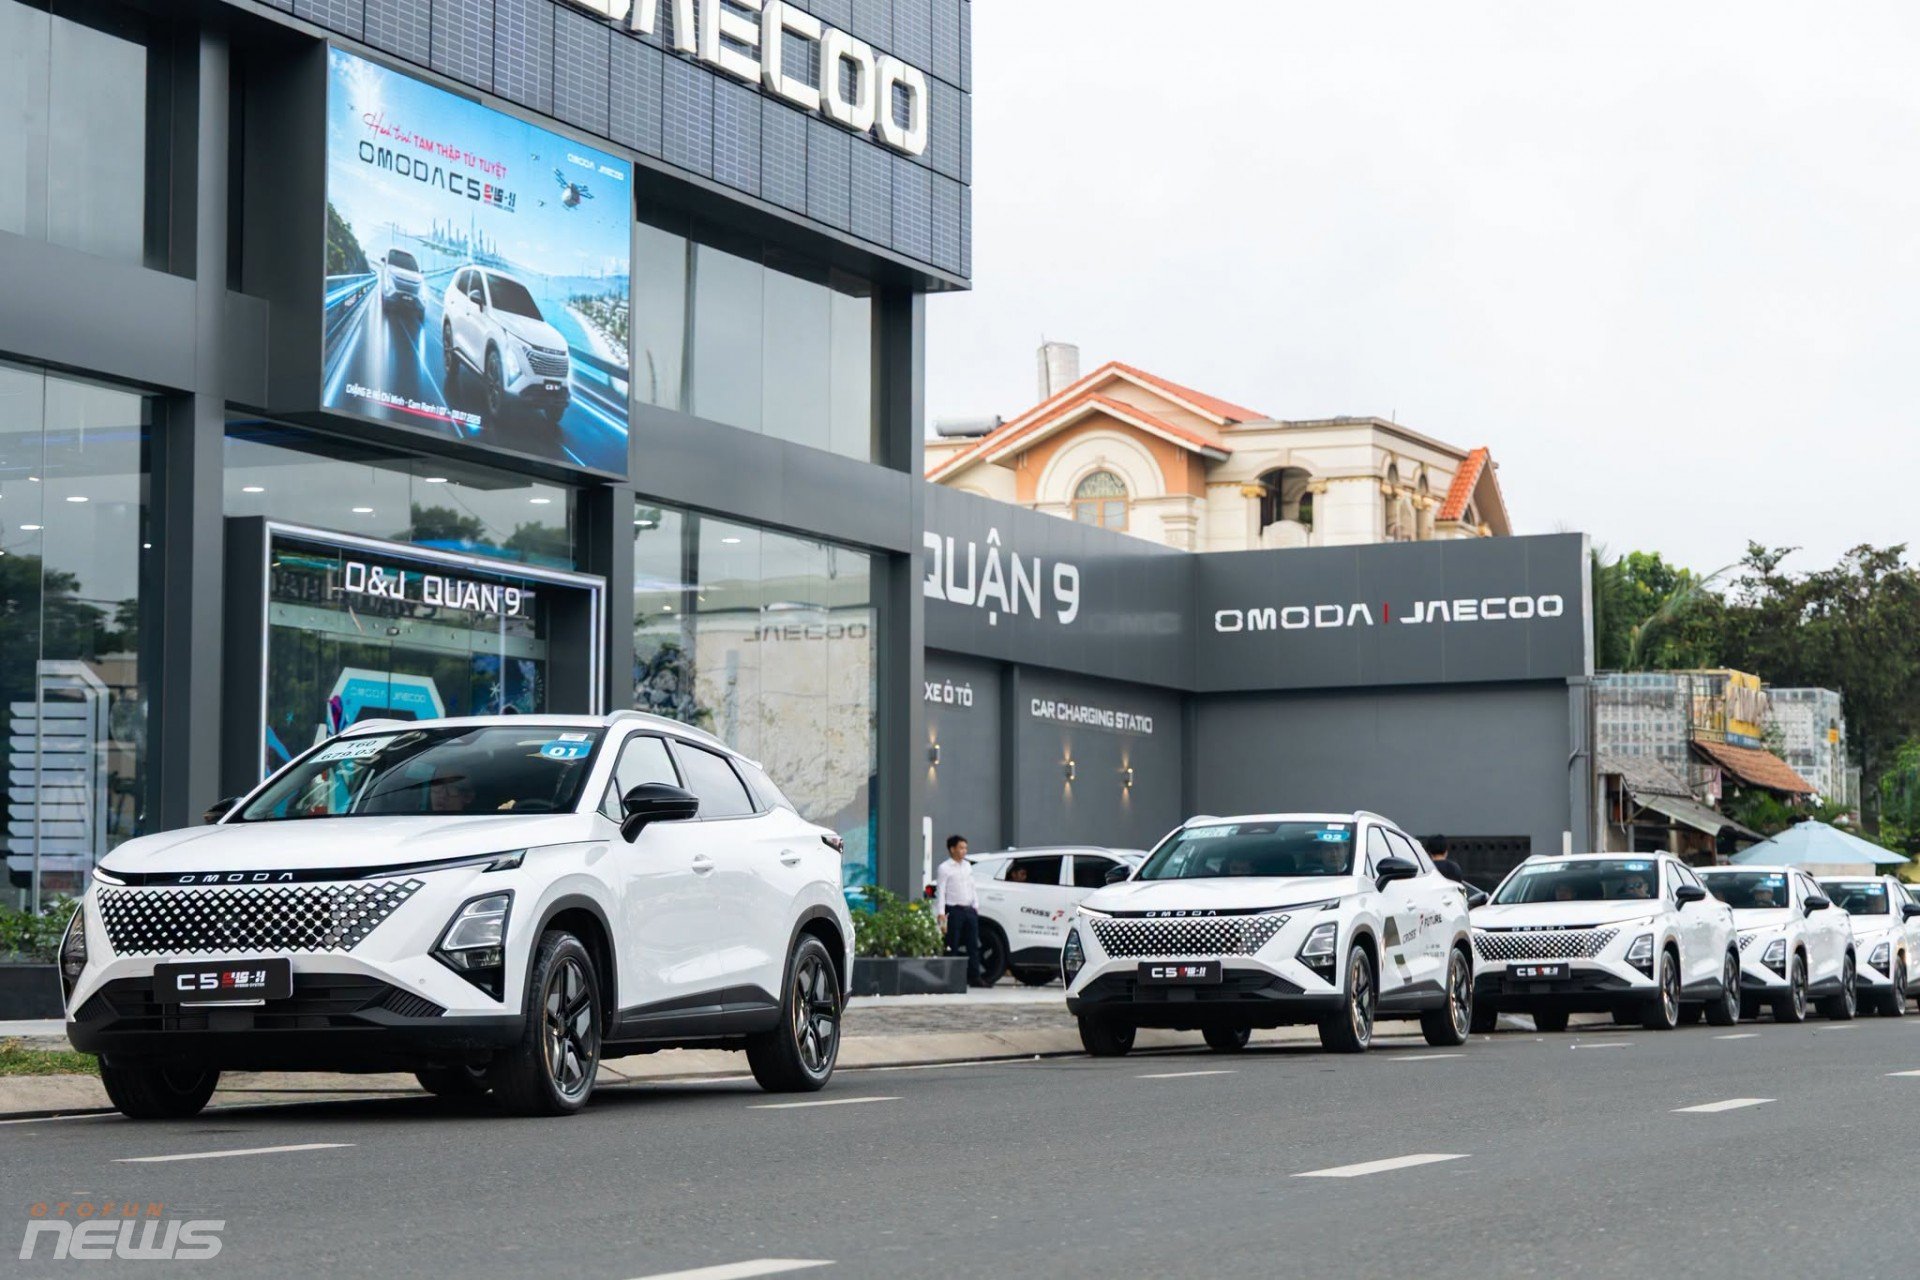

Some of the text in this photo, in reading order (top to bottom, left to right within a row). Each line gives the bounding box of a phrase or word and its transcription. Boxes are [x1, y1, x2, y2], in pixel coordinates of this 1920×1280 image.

[568, 0, 928, 156] AECOO
[423, 575, 498, 614] QUAN
[505, 587, 520, 616] 9
[1053, 561, 1080, 624] 9
[1214, 594, 1564, 633] OMODA JAECOO
[924, 679, 973, 707] XE Ô TÔ
[1031, 698, 1056, 719] CAR
[1057, 702, 1114, 728] CHARGING
[549, 746, 578, 758] 01
[179, 871, 294, 883] OMODA
[1020, 906, 1050, 917] CROSS
[176, 972, 219, 991] C5
[1151, 967, 1178, 979] C5
